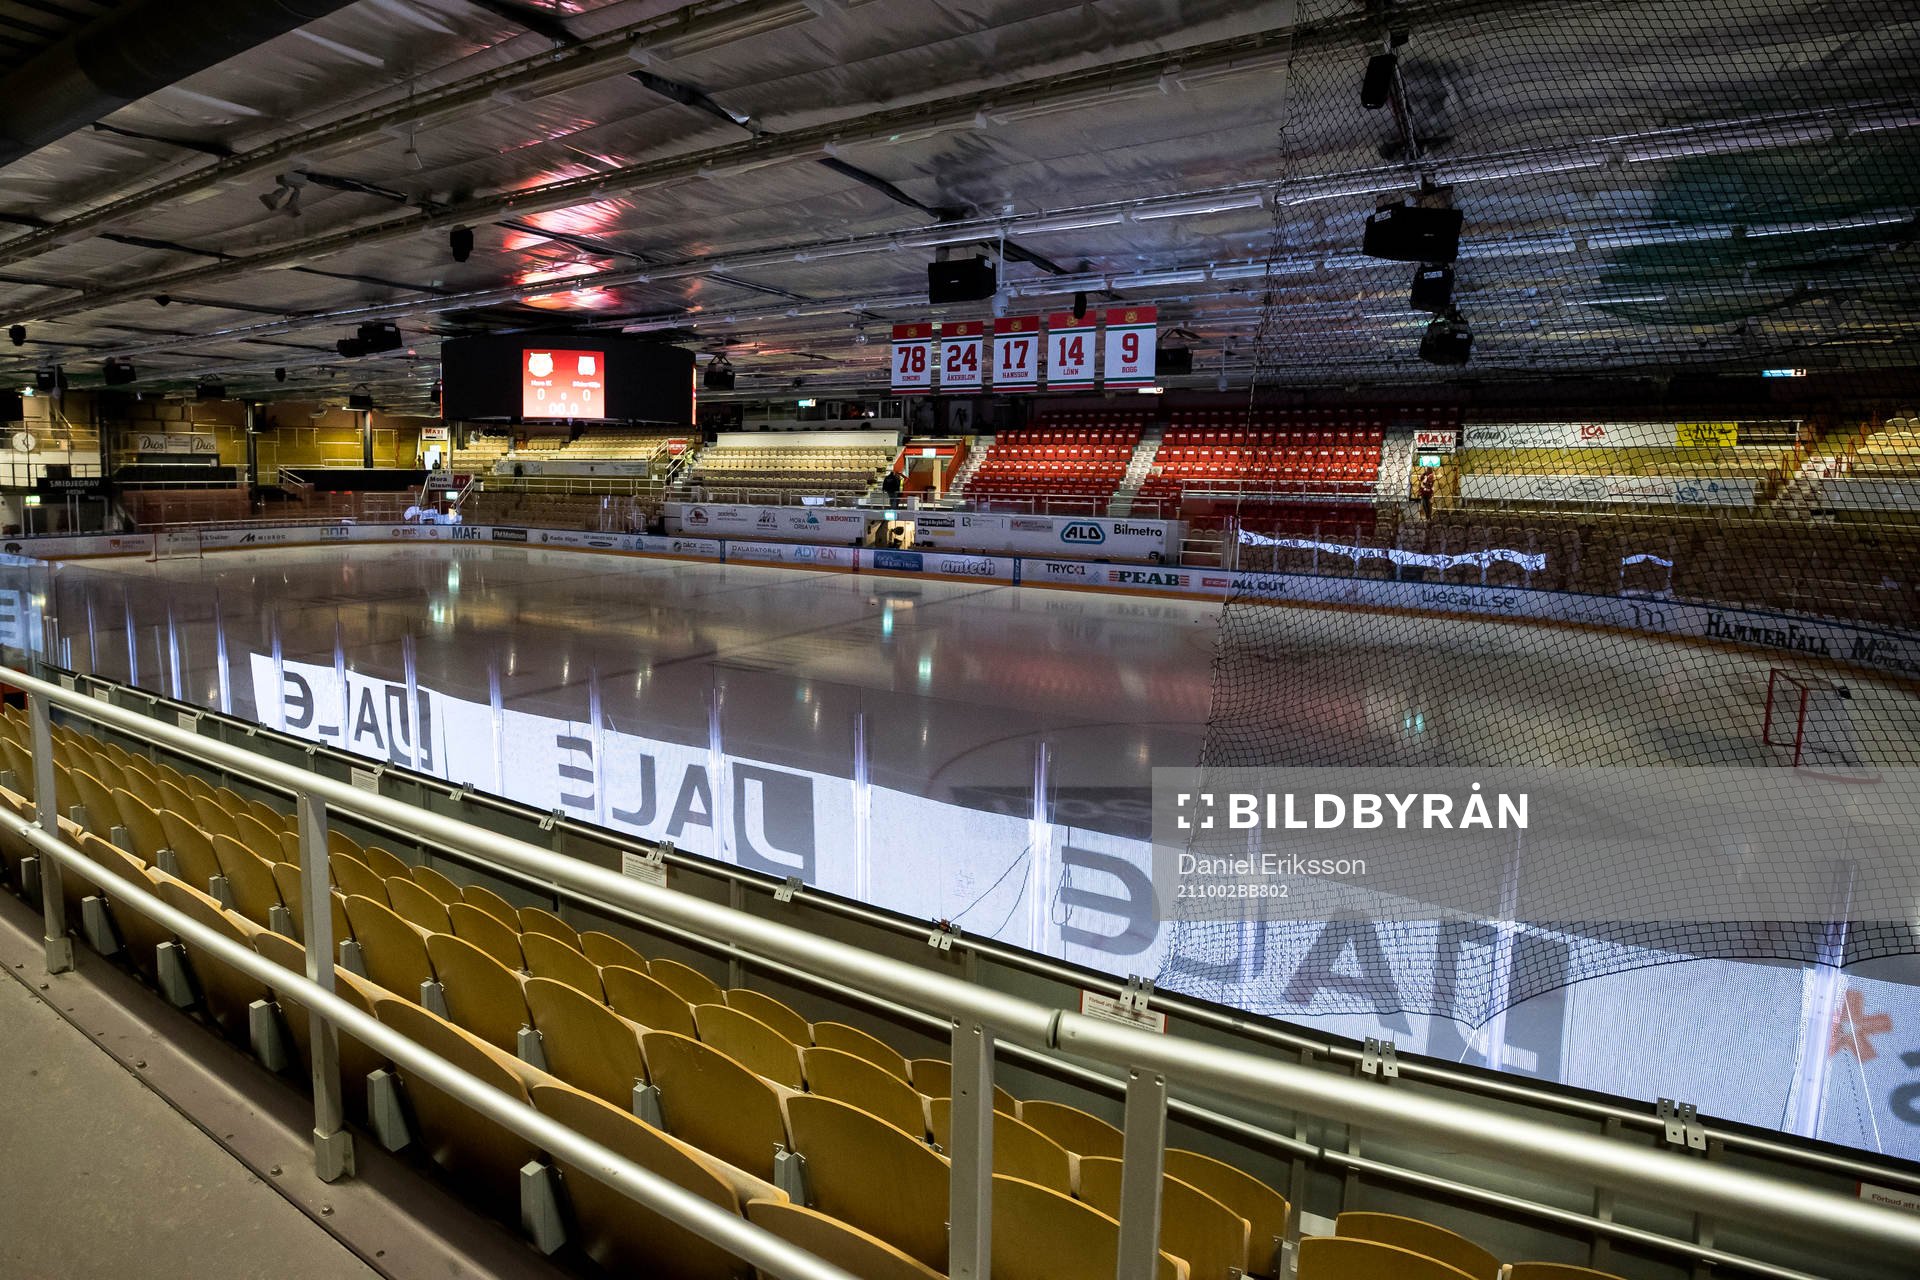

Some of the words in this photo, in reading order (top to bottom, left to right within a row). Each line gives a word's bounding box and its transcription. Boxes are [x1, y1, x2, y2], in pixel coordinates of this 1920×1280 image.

[1002, 340, 1029, 369] 17
[1058, 336, 1084, 366] 14
[1121, 333, 1139, 363] 9
[897, 346, 926, 373] 78
[947, 344, 977, 372] 24
[537, 388, 545, 401] 0
[582, 389, 590, 402] 0
[1581, 425, 1605, 436] ICA
[1113, 523, 1163, 537] Bilmetro
[794, 546, 836, 560] ADVEN
[941, 559, 995, 576] amtech
[1118, 571, 1180, 586] PEAB
[1703, 612, 1829, 656] HAMMERFALL
[1872, 1193, 1902, 1206] Förbud
